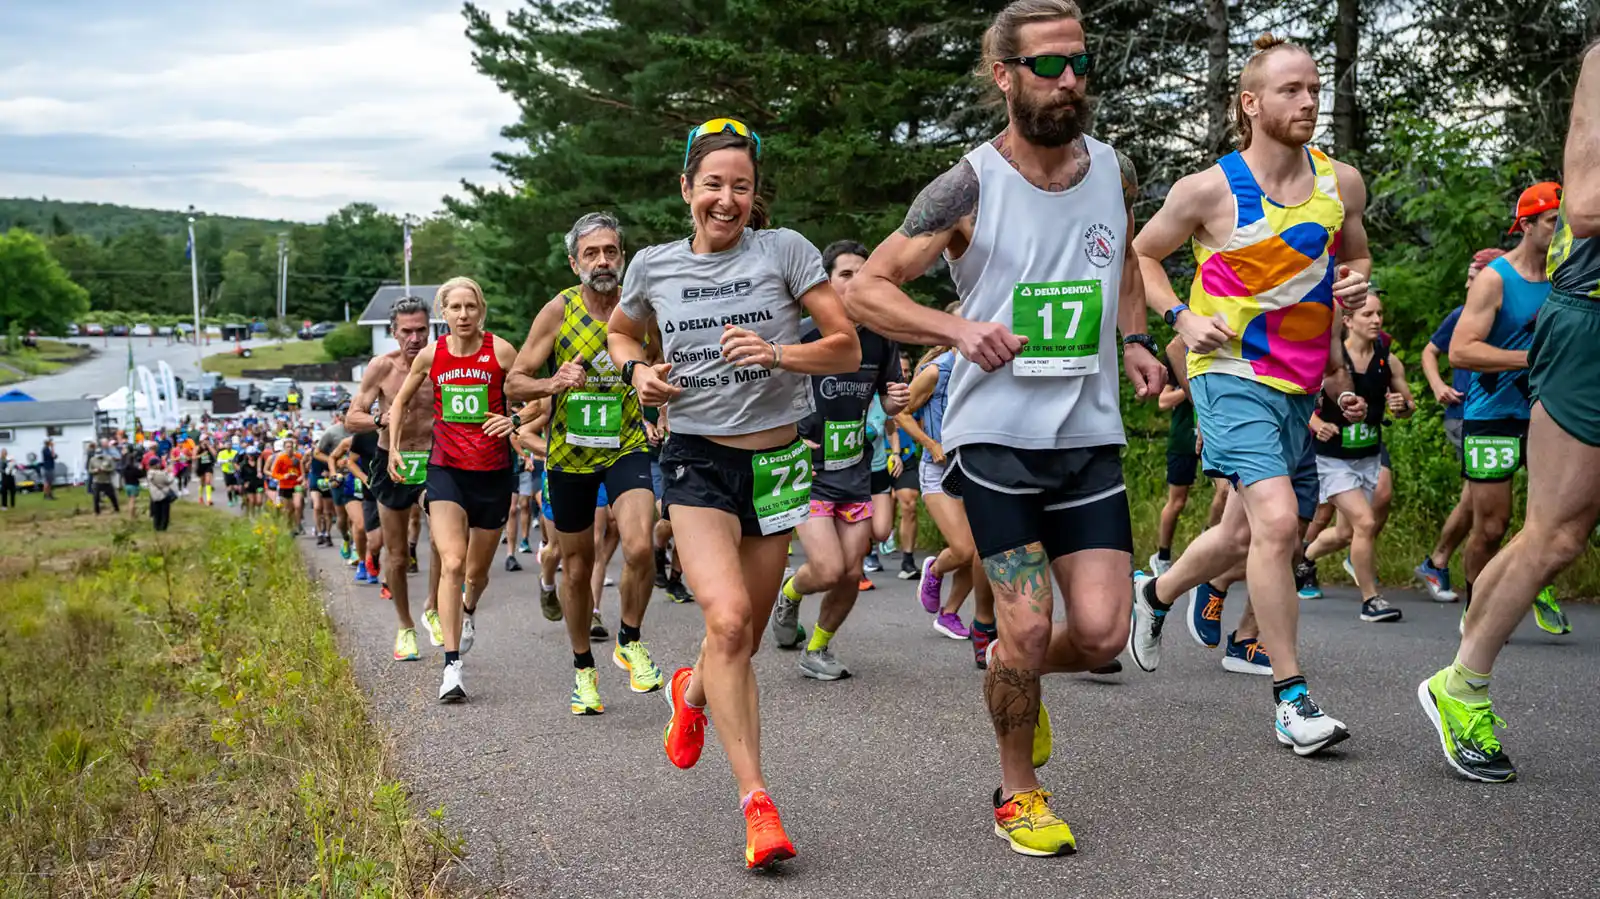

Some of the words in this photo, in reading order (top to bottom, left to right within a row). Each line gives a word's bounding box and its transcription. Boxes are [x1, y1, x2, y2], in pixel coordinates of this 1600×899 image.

[1034, 288, 1060, 296] DELTA
[1062, 285, 1093, 295] DENTAL
[679, 317, 718, 332] DELTA
[721, 310, 773, 326] DENTAL
[1037, 300, 1083, 340] 17
[672, 346, 723, 363] Charlie'
[437, 367, 492, 385] WHIRLAWAY
[680, 373, 730, 388] Ollies's
[734, 368, 771, 384] Mom
[451, 394, 479, 414] 60
[581, 403, 607, 427] 11
[769, 453, 793, 464] DELTA
[1469, 446, 1515, 469] 133
[408, 460, 420, 477] 7
[771, 458, 812, 497] 72
